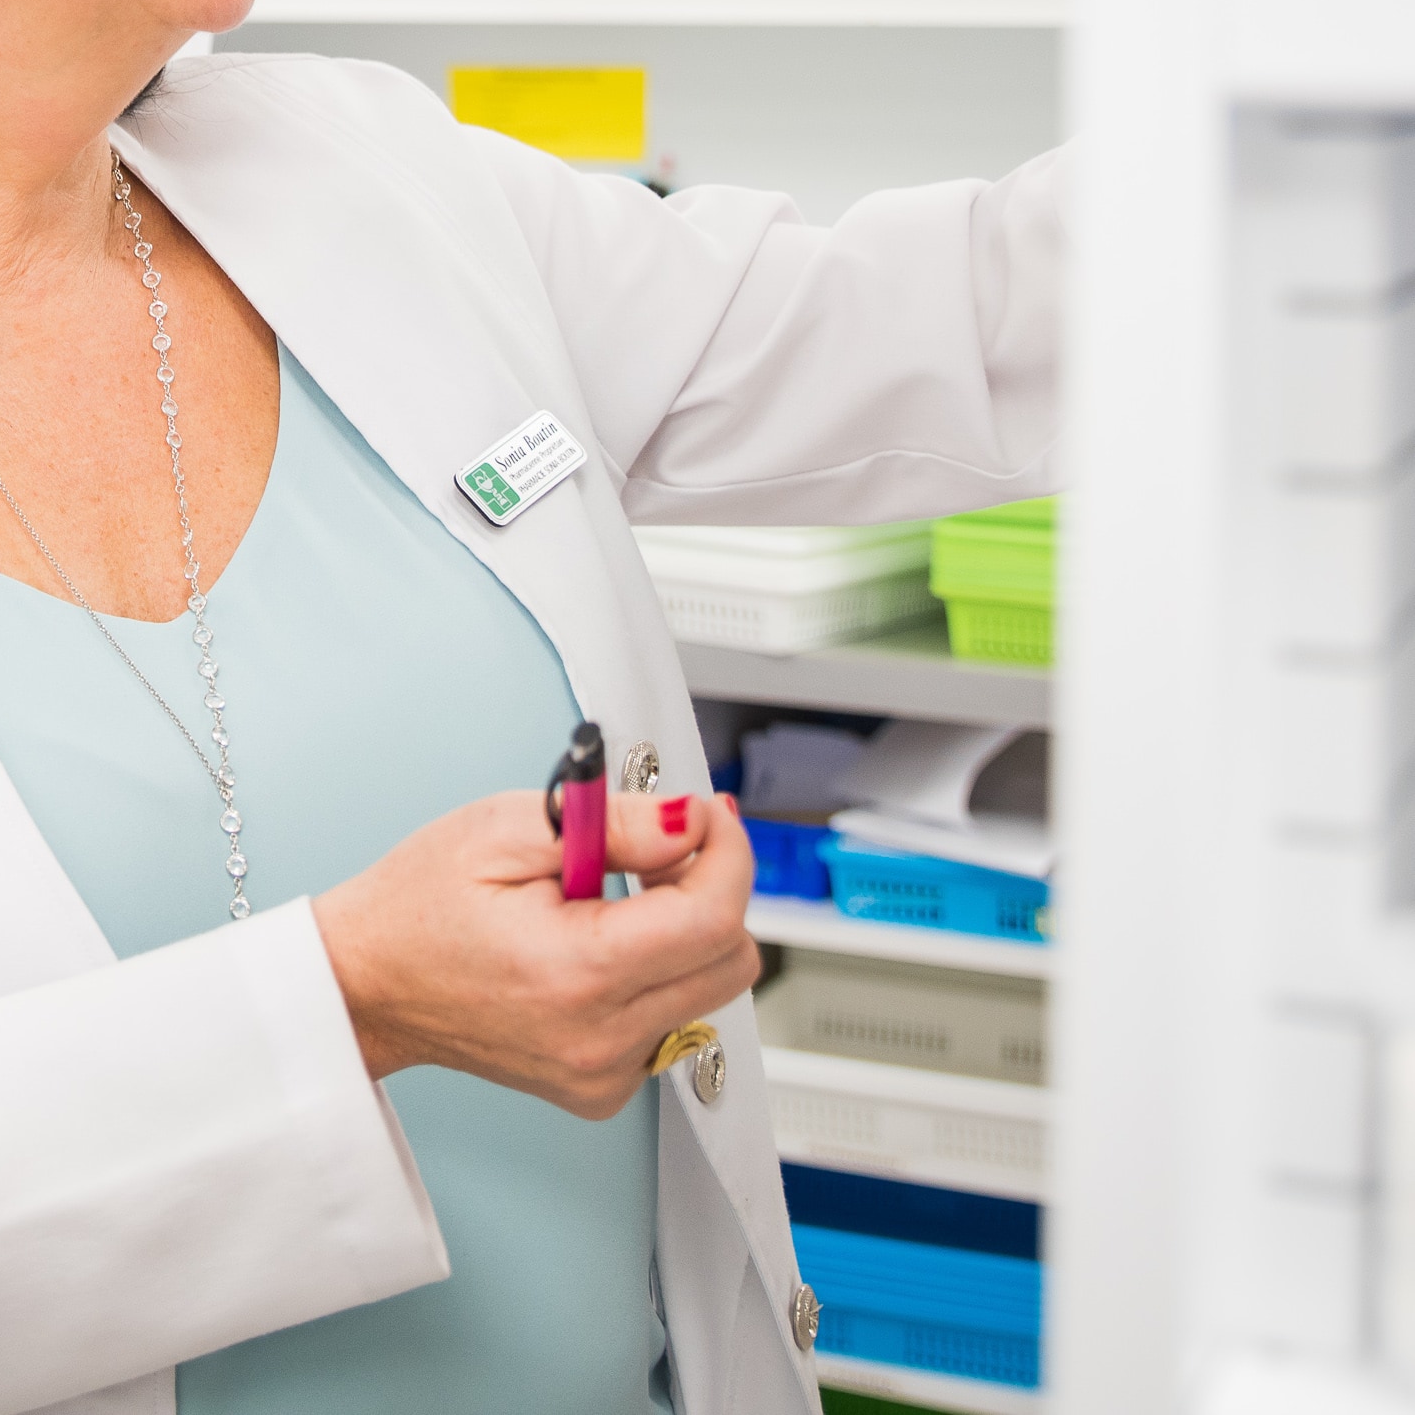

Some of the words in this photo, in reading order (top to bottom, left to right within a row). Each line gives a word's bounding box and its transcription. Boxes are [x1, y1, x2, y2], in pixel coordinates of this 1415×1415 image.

[495, 445, 526, 472] Sonia
[523, 423, 558, 451] Boutin
[518, 470, 546, 494] PHARMACIE
[544, 460, 559, 473] SONIA
[557, 446, 576, 463] BOUTIN
